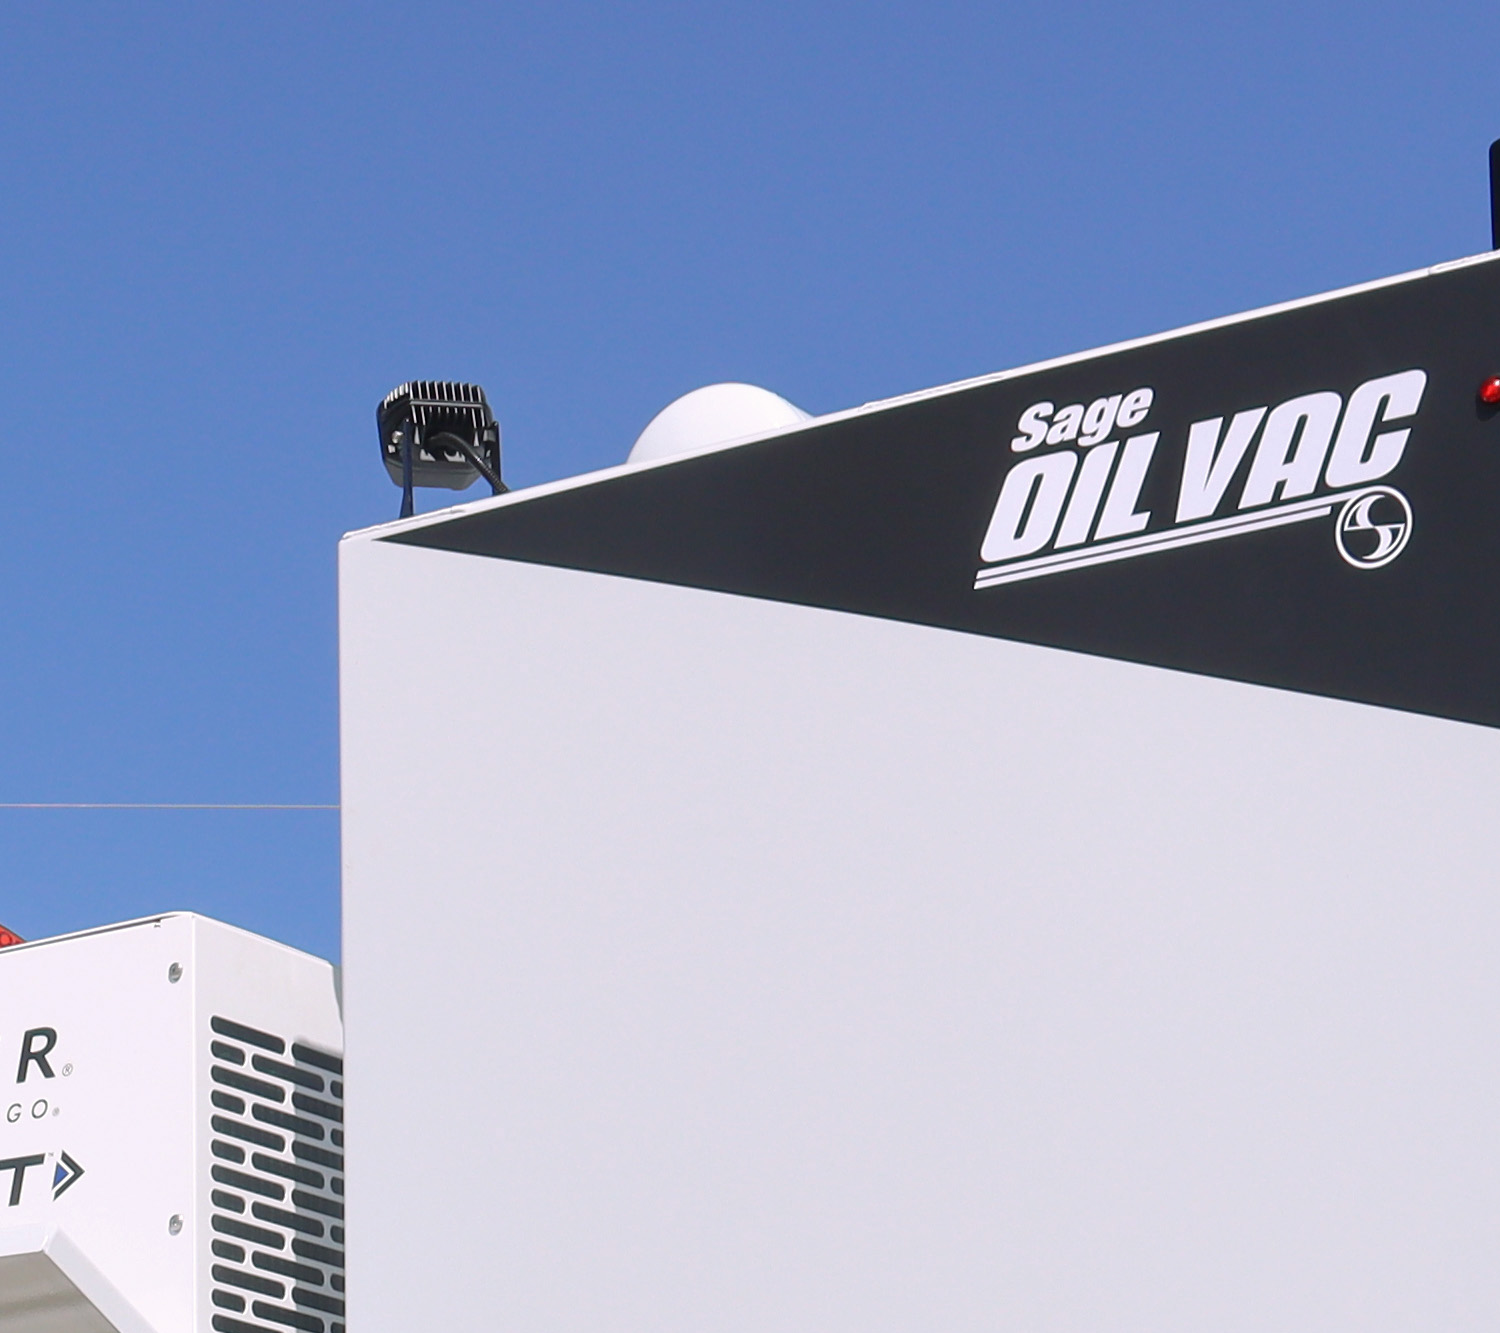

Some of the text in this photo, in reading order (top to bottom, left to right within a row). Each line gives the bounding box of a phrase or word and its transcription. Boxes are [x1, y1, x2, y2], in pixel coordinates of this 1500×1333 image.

[1011, 386, 1154, 452] Sage
[980, 369, 1427, 562] OIL VAC
[7, 1099, 48, 1124] GO
